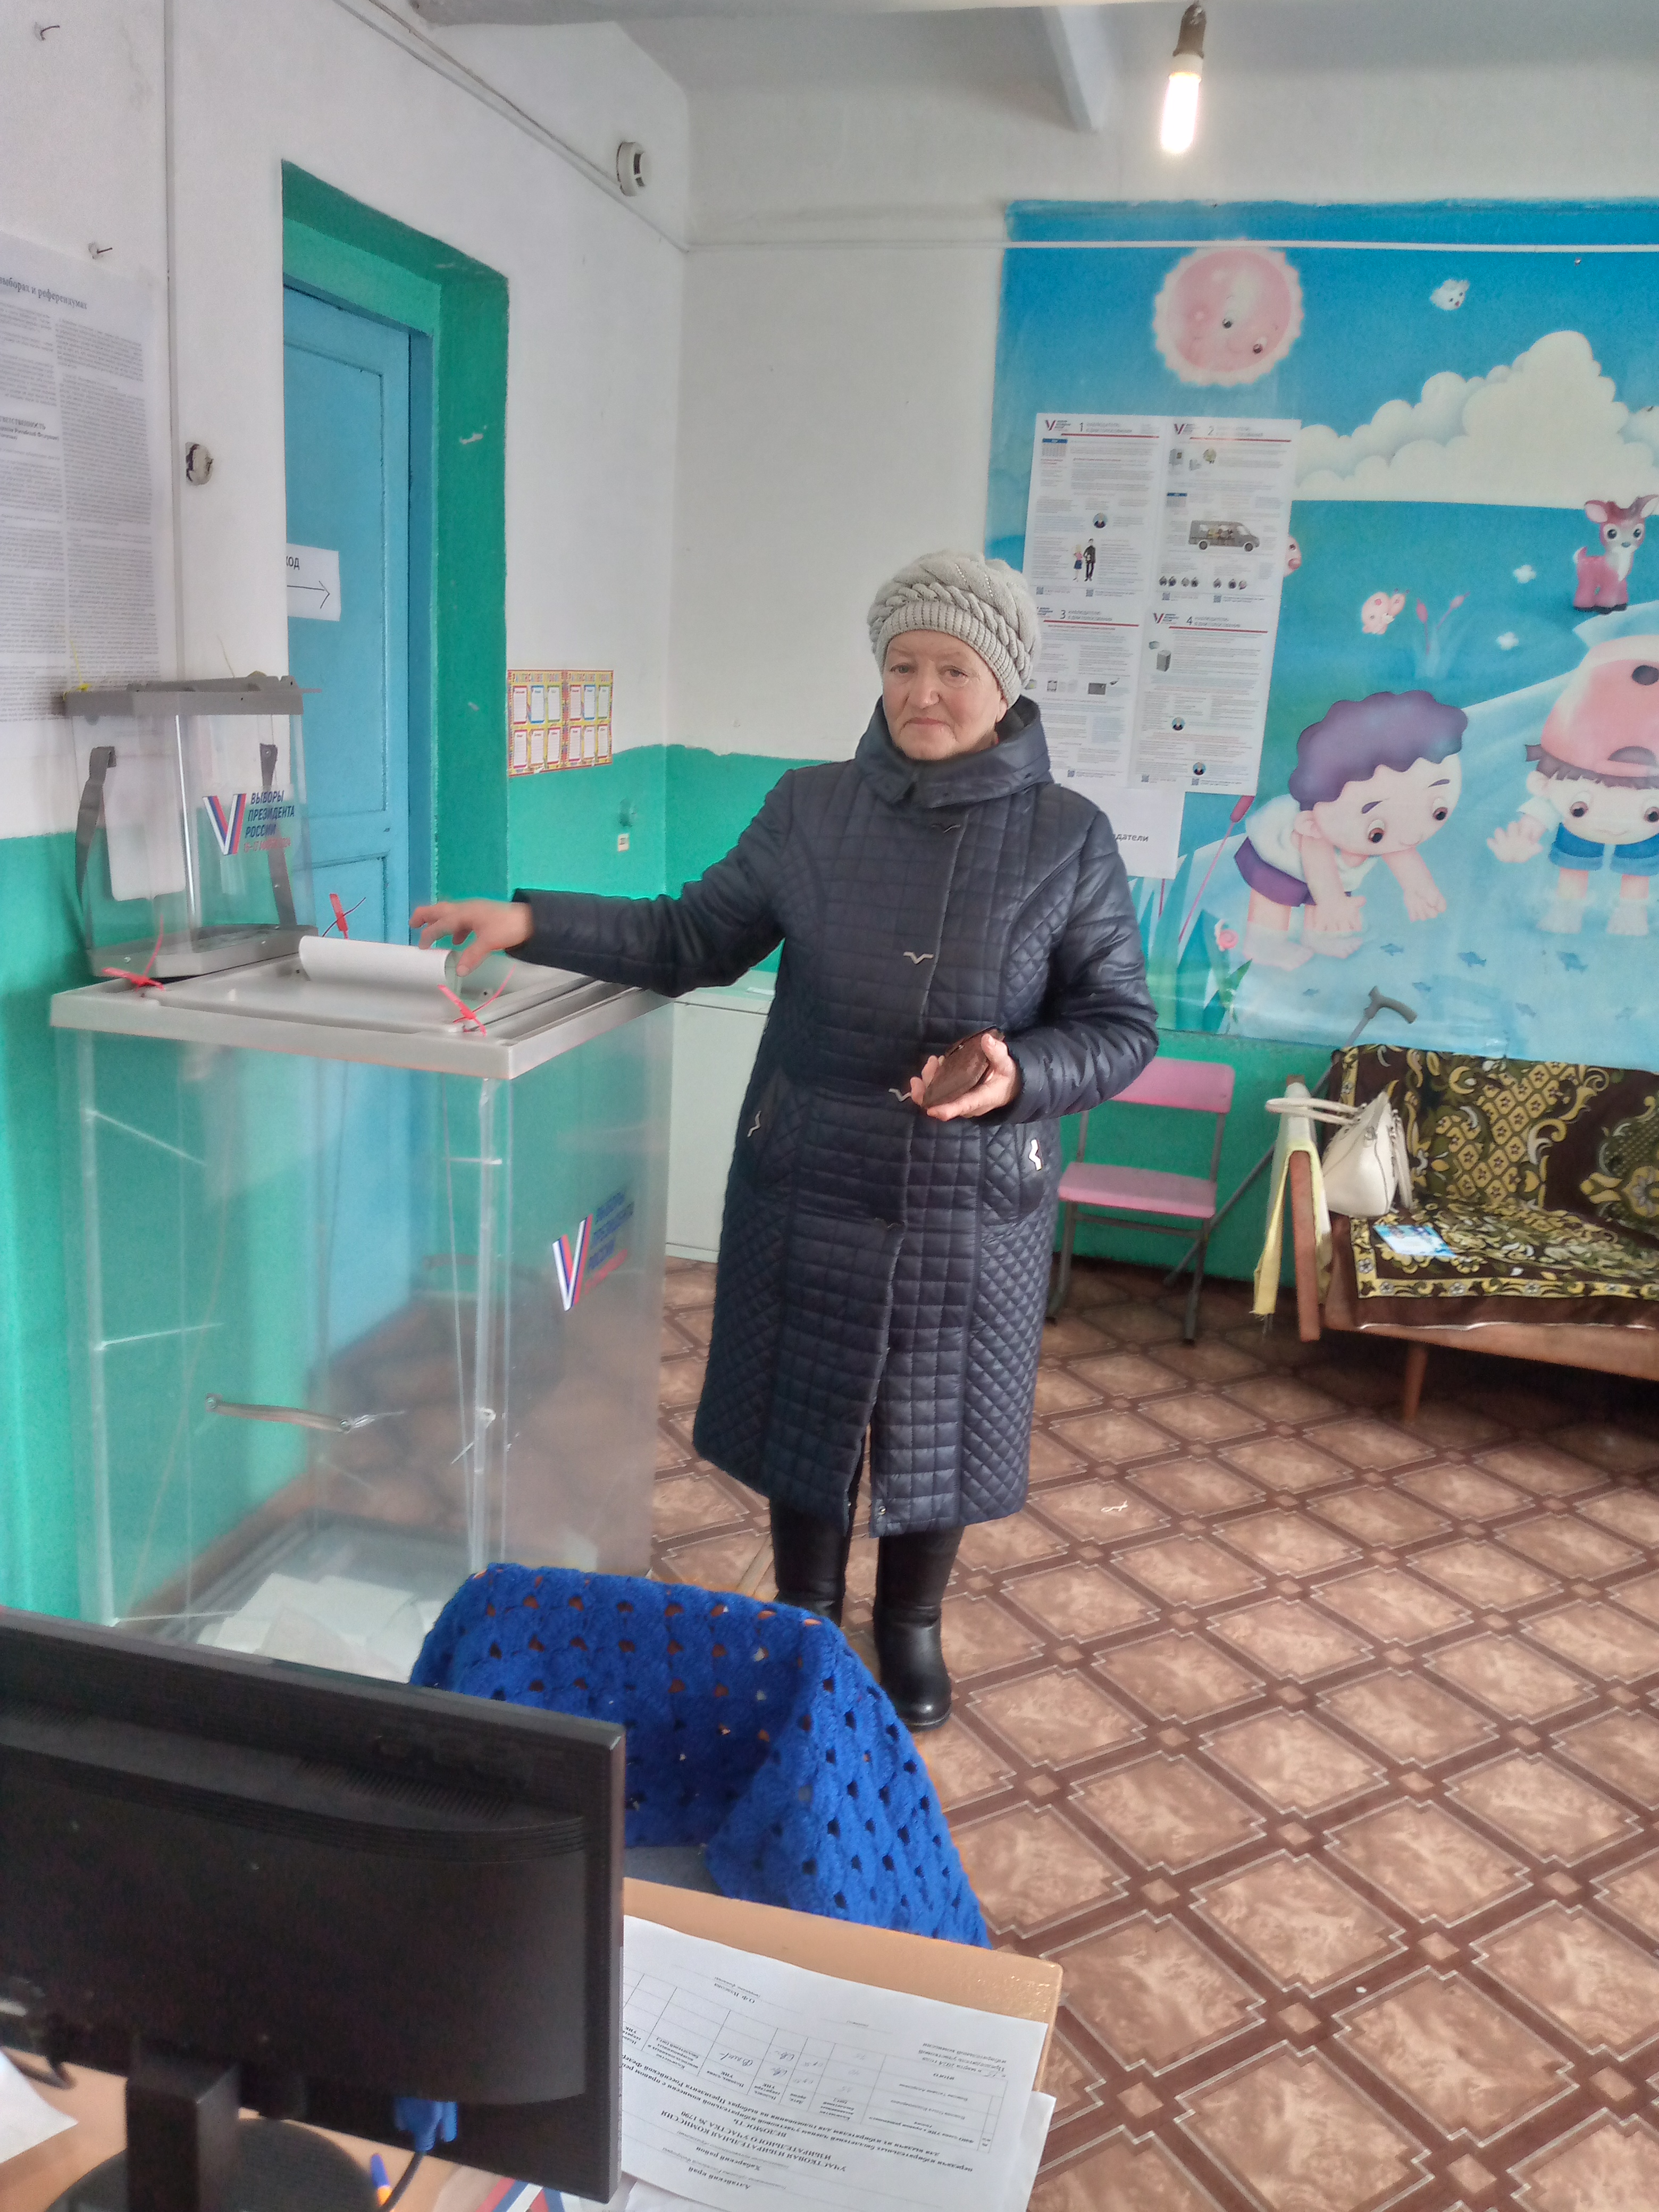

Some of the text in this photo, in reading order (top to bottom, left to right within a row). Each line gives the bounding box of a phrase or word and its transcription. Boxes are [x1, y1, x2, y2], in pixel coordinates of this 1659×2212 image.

[1060, 609, 1066, 619] 3
[1186, 616, 1193, 626] 4
[250, 790, 284, 805] ВЫБОРЫ
[248, 805, 295, 822] ПРЕЗИДЕНТА
[245, 824, 276, 839] РОССИИ
[1116, 834, 1149, 842] датели
[713, 1983, 739, 1997] Власова
[634, 2069, 661, 2083] правом
[643, 2065, 684, 2086] Российской
[666, 2084, 701, 2101] комиссии
[684, 2083, 726, 2103] Президента
[701, 2099, 757, 2122] избирательной
[727, 2100, 758, 2115] выборах
[680, 2110, 697, 2121] 1790
[708, 2122, 749, 2139] УЧАСТКА
[732, 2118, 787, 2138] ВЕДОМОСТЬ
[757, 2119, 801, 2131] участковой
[660, 2110, 847, 2171] УЧАСТКОВАЯ ИЗБИРАТЕЛЬНАЯ КОМИССИЯ
[801, 2130, 828, 2139] членам
[833, 2130, 881, 2144] избирателям
[750, 2135, 831, 2160] ИЗБИРАТЕЛЬНОГО
[830, 2136, 875, 2150] бюллетеней
[695, 2147, 761, 2171] Хабарский район
[876, 2146, 936, 2164] избирательных
[936, 2160, 973, 2172] передачи
[688, 2166, 751, 2190] Алтайский край
